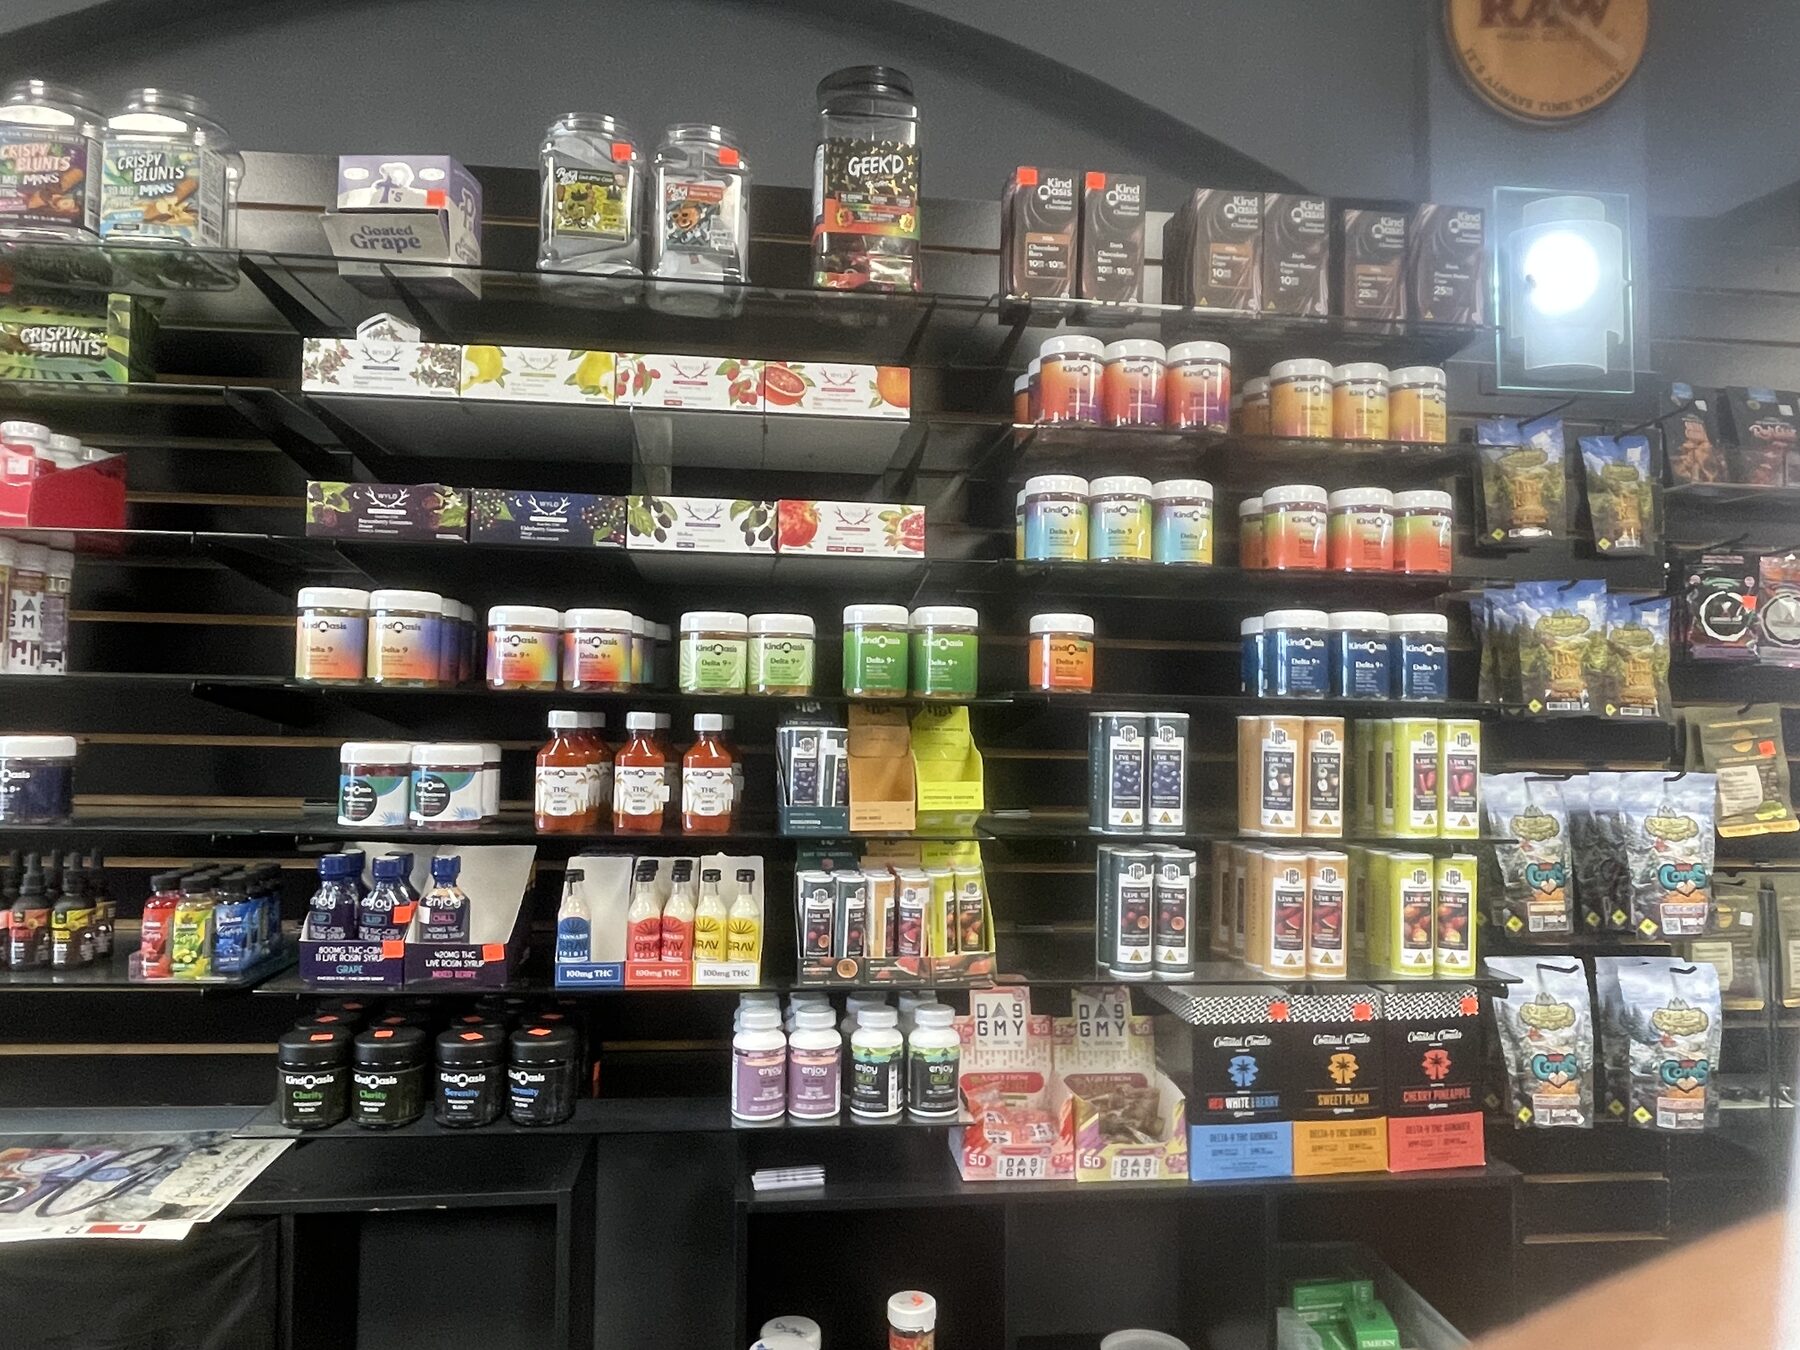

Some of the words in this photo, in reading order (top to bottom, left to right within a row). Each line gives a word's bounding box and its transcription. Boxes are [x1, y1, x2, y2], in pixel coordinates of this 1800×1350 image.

[16, 156, 71, 172] BLUNTS
[118, 153, 163, 170] CRISPY
[848, 154, 904, 176] GEEK'D
[133, 165, 184, 182] BLUNTS
[1047, 177, 1073, 188] Kind
[1115, 184, 1140, 194] Kind
[1233, 195, 1259, 207] Kind
[1300, 200, 1325, 212] Kind
[1381, 216, 1405, 228] Kind
[1457, 211, 1481, 222] Kind
[360, 224, 414, 236] Goated
[350, 233, 422, 253] Grape
[764, 641, 805, 654] KindOasis
[701, 659, 721, 667] Delta
[770, 657, 789, 665] Delta
[866, 656, 885, 664] Delta
[1355, 661, 1374, 669] Delta
[1412, 664, 1431, 672] Delta
[336, 965, 363, 974] GRAPE
[566, 970, 593, 979] 100mg
[594, 969, 613, 977] THC
[636, 970, 662, 979] 100mg
[664, 969, 681, 977] THC
[703, 970, 730, 979] 100mg
[977, 1020, 1024, 1037] GMY
[1033, 1024, 1048, 1034] 50
[1079, 1021, 1126, 1037] GMY
[1134, 1024, 1149, 1034] 50
[1213, 1036, 1243, 1048] Coastal
[1244, 1034, 1273, 1047] Clouds
[1313, 1034, 1343, 1046] Coastal
[1344, 1032, 1371, 1044] Clouds
[1407, 1031, 1436, 1043] Coastal
[1437, 1028, 1463, 1041] Clouds
[758, 1067, 782, 1076] enjoy
[801, 1067, 827, 1077] enjoy
[854, 1064, 878, 1074] enjoy
[929, 1065, 953, 1075] enjoy
[285, 1074, 334, 1089] KindOasis
[440, 1073, 486, 1087] KindOasis
[292, 1089, 324, 1100] Clarity
[359, 1090, 387, 1100] Clarity
[444, 1087, 480, 1099] Serenity
[1403, 1090, 1433, 1103] CHERRY
[1225, 1097, 1250, 1109] WHITE
[1318, 1094, 1343, 1106] SWEET
[1344, 1093, 1370, 1105] PEACH
[968, 1154, 986, 1166] 50
[1083, 1155, 1101, 1168] 50
[1006, 1168, 1038, 1177] GMY
[1119, 1168, 1152, 1177] GMY
